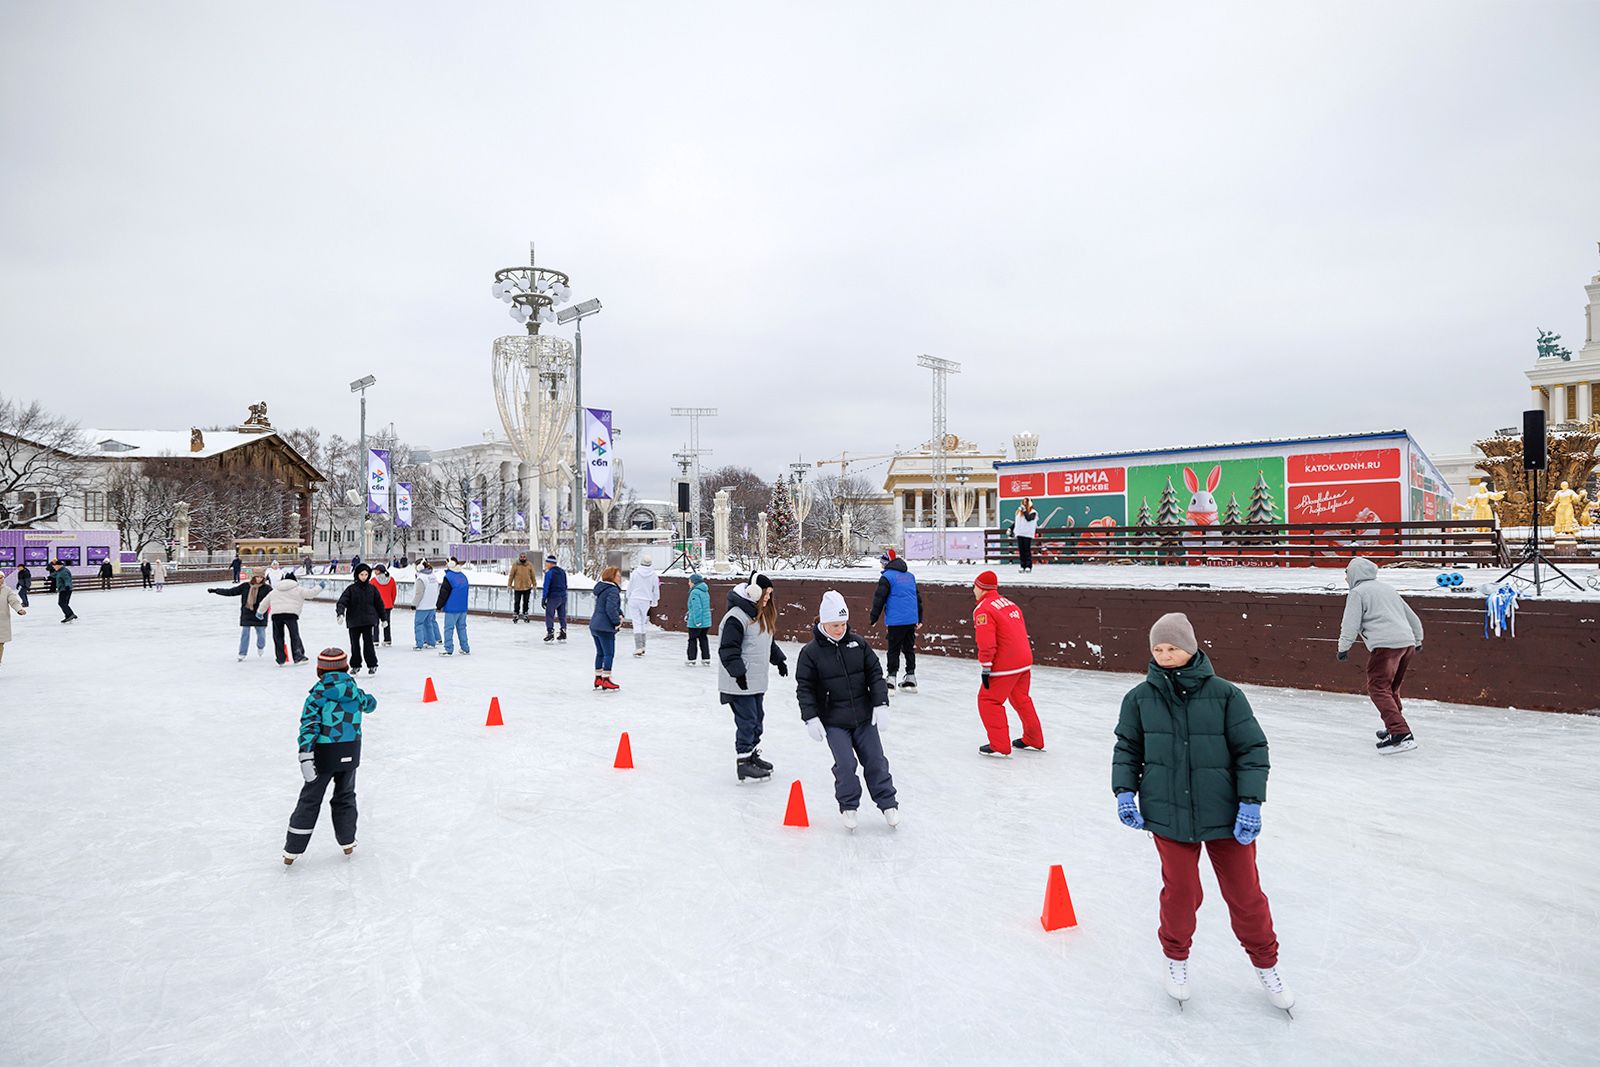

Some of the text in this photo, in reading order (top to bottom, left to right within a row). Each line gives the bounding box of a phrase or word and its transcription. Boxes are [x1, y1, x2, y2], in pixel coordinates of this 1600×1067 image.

[592, 459, 608, 467] сбп
[1305, 461, 1381, 473] KATOK.VDNH.RU
[1064, 471, 1109, 485] ЗИМА
[1072, 483, 1110, 492] МОСКВЕ
